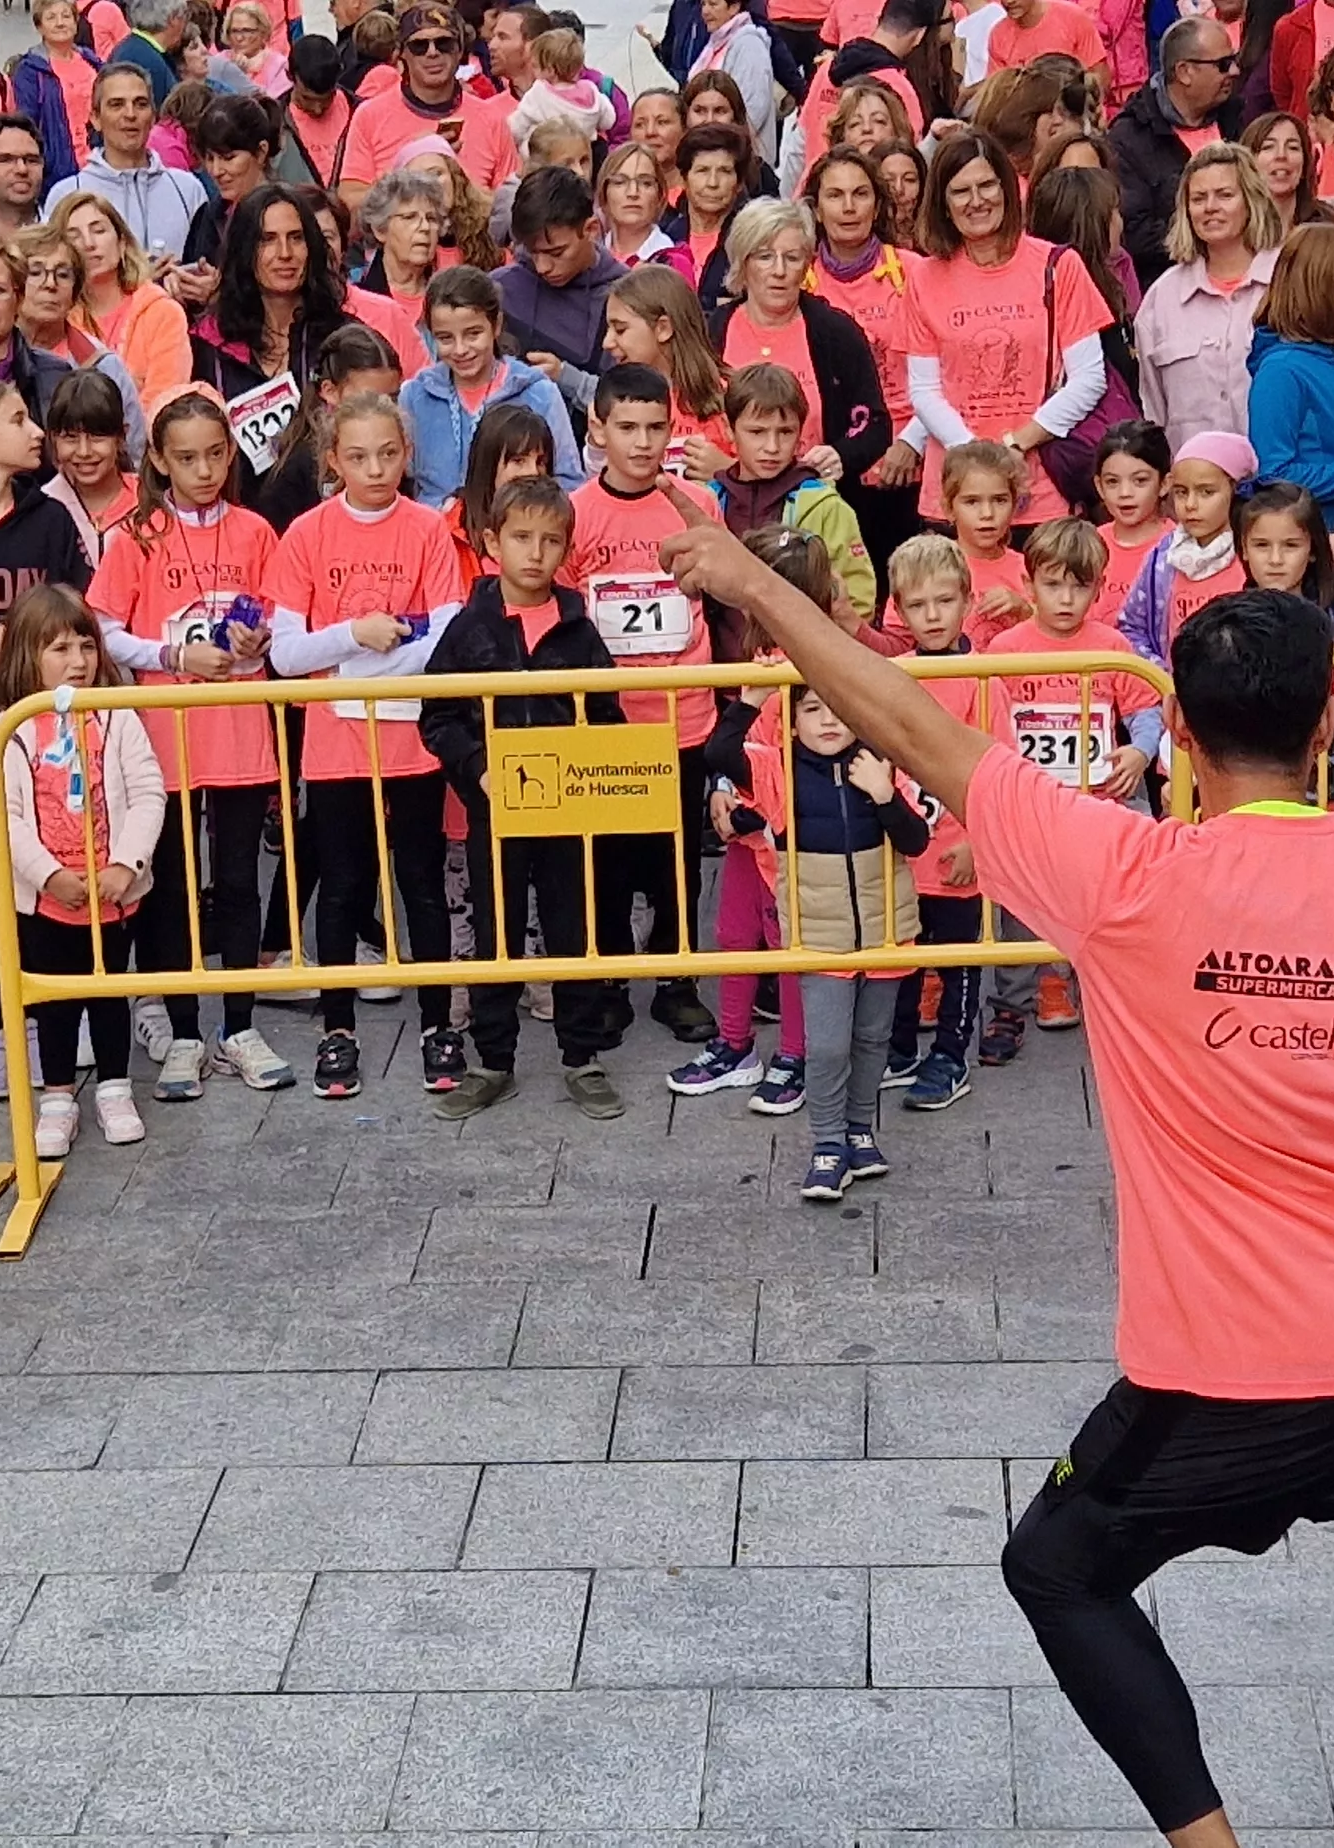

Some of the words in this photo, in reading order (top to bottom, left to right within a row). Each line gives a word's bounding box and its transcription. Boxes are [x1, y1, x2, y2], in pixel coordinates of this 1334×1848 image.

[622, 602, 663, 633] 21
[1045, 676, 1100, 690] CÁNCR
[1019, 734, 1101, 766] 2319
[565, 761, 673, 781] Ayuntamiento
[565, 783, 585, 797] de
[588, 781, 649, 797] Huesca
